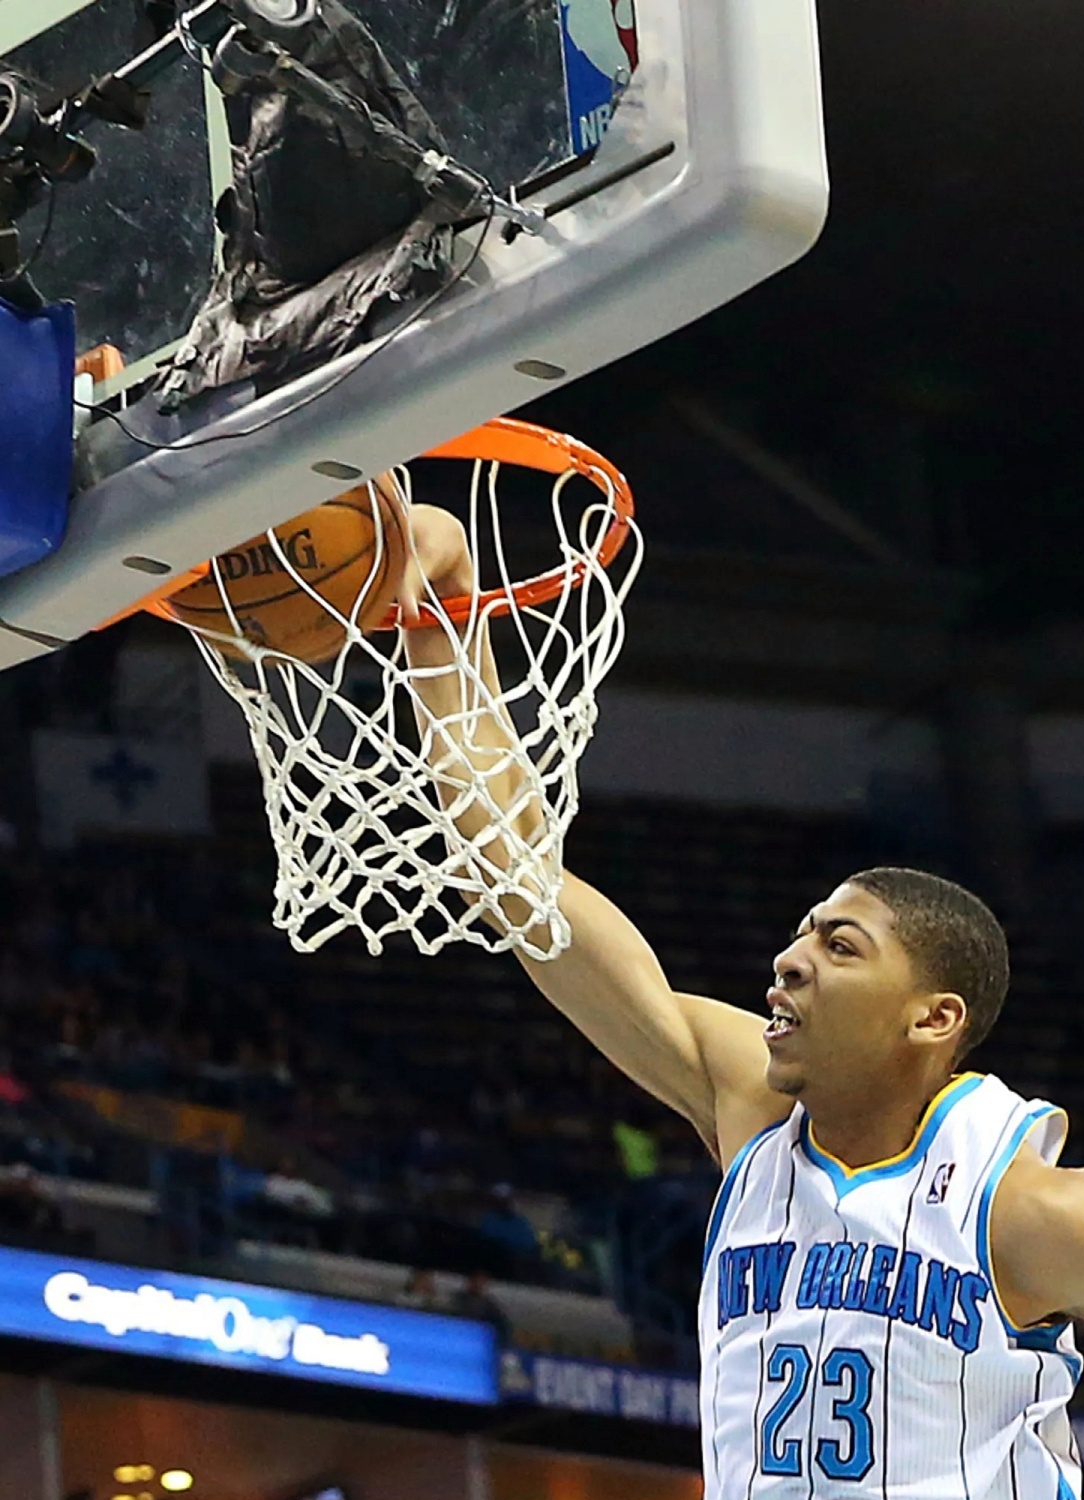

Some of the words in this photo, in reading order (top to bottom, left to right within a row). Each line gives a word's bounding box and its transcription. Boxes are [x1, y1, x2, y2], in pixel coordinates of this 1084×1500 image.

[579, 103, 611, 150] NB
[718, 1241, 796, 1330] NEW
[797, 1241, 992, 1355] ORLEANS
[761, 1344, 875, 1482] 23
